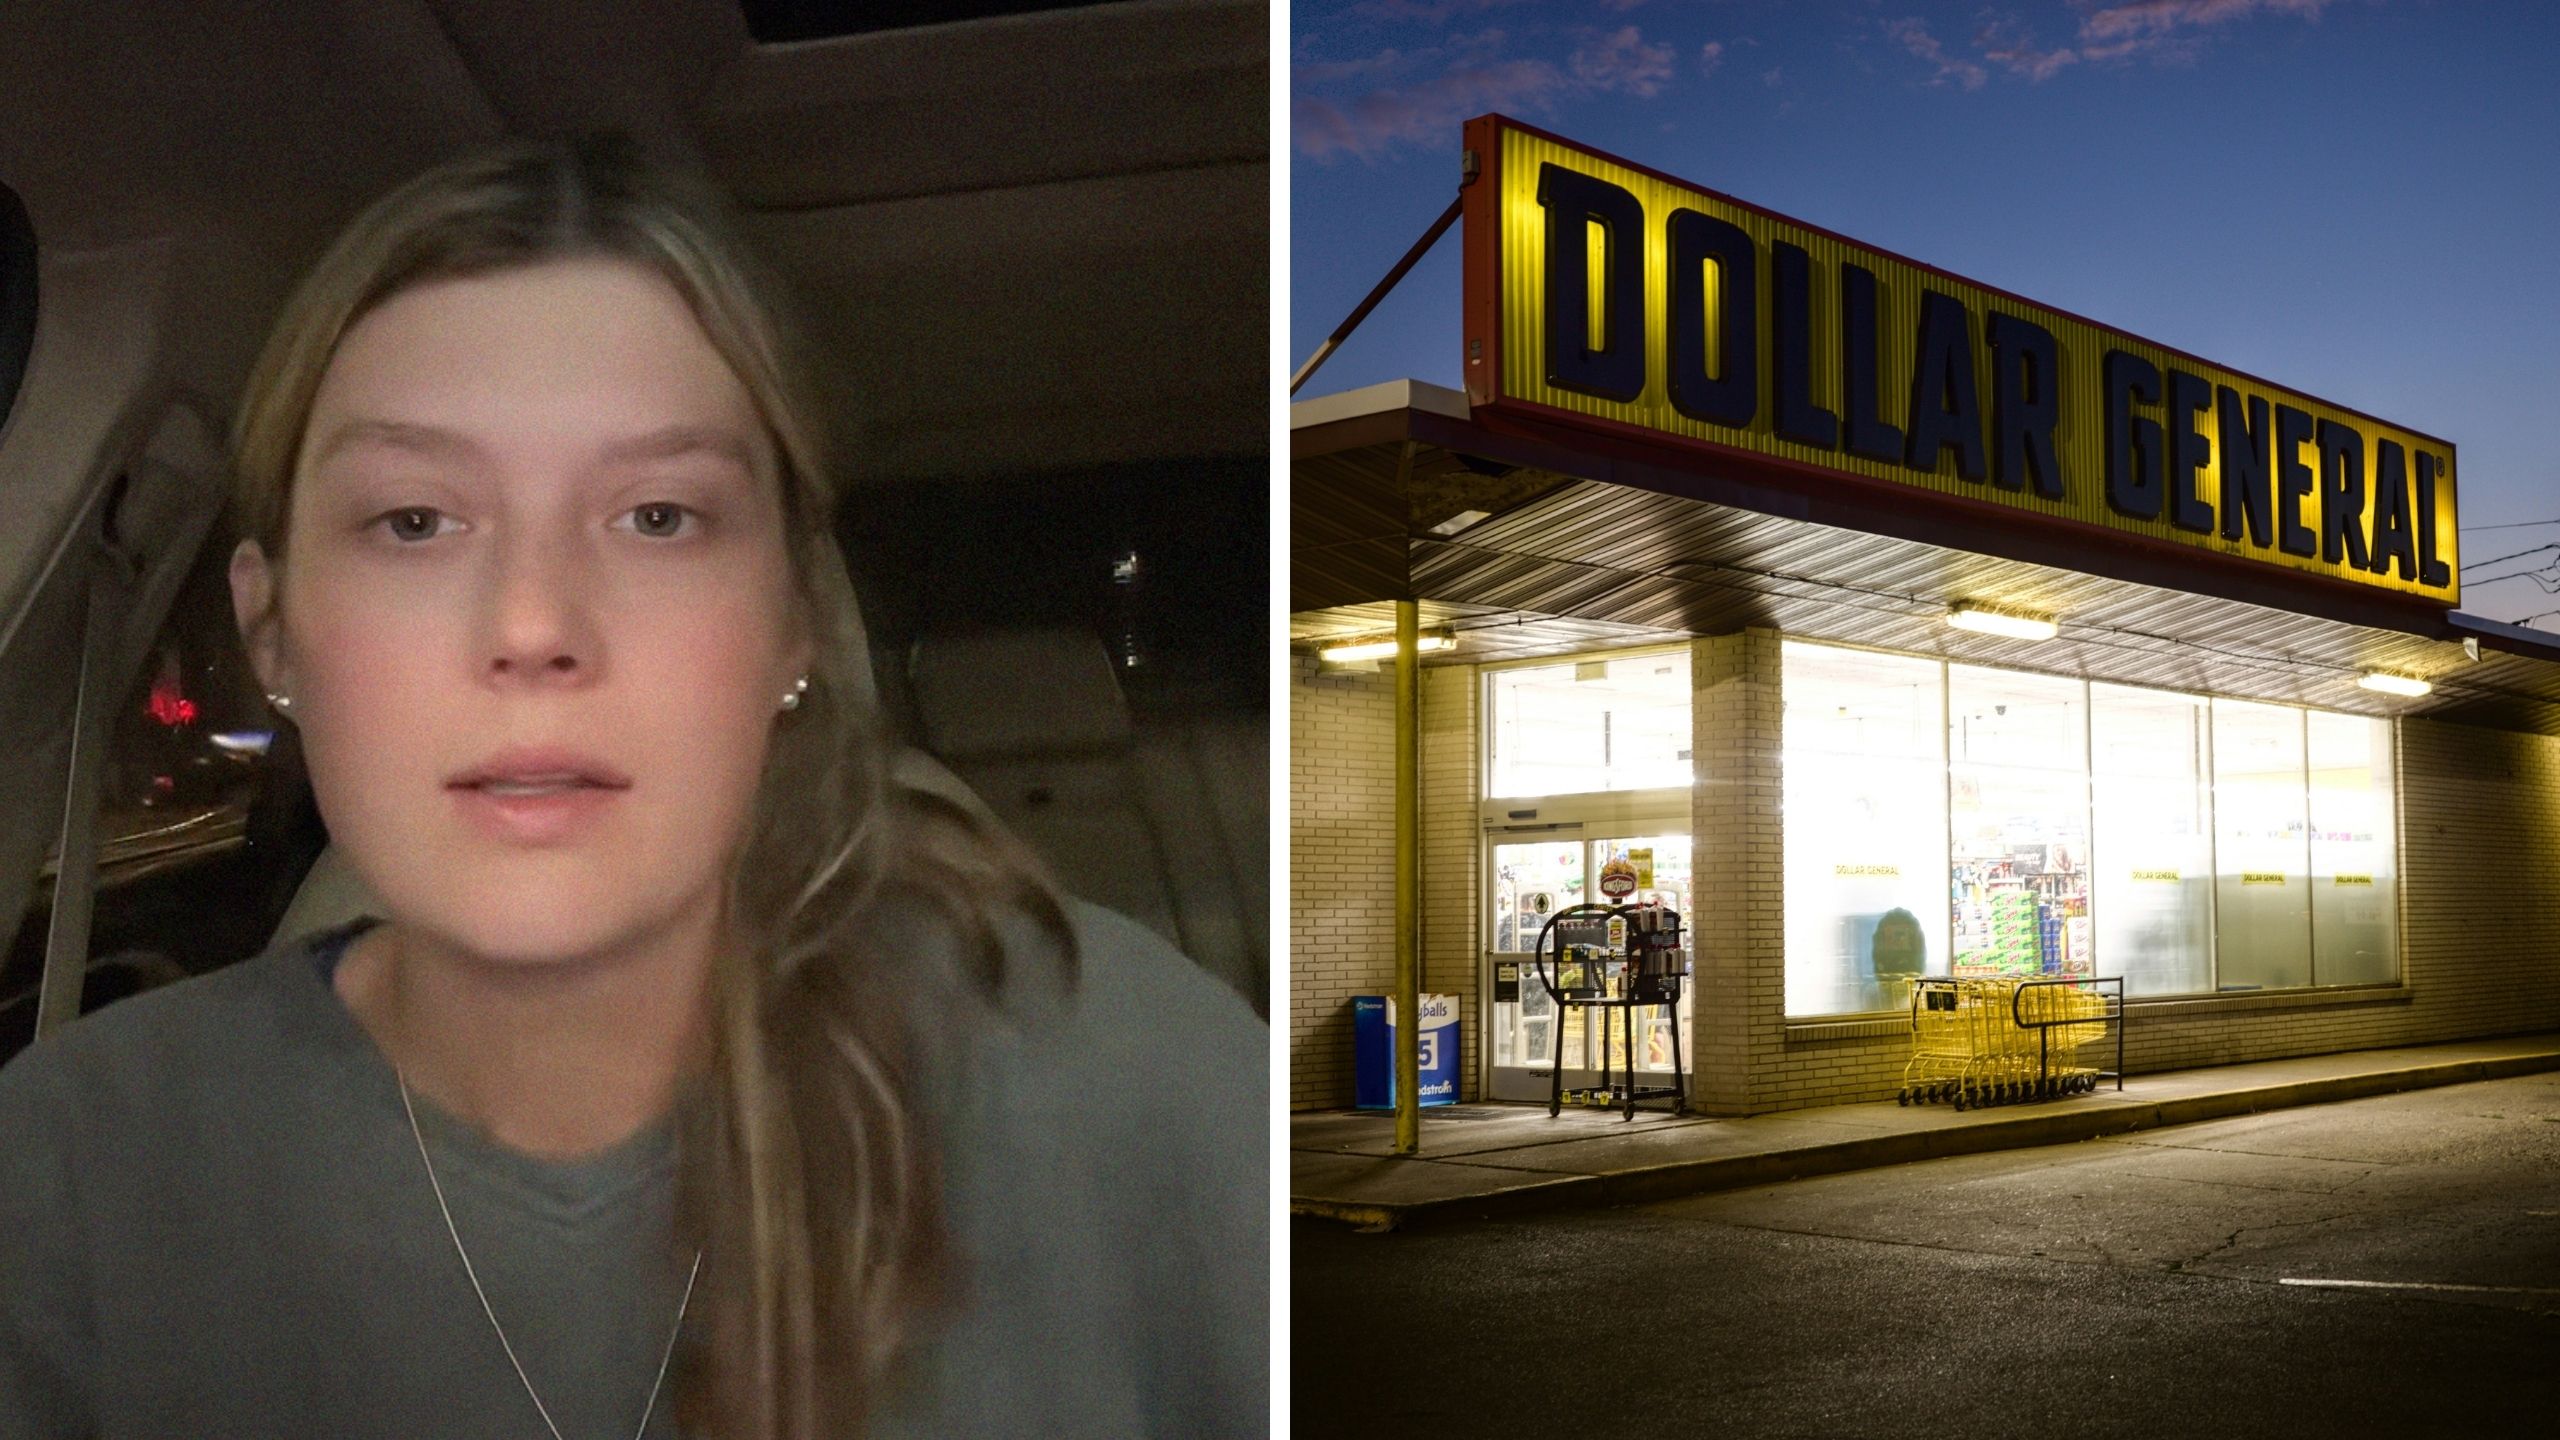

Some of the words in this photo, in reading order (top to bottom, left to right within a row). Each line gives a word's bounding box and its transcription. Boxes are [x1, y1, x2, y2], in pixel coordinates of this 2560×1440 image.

[1537, 161, 2063, 498] DOLLAR
[2103, 349, 2449, 588] GENERAL
[1836, 865, 1864, 875] DOLLAR
[1867, 865, 1899, 876] GENERAL
[2132, 871, 2153, 880] DOLLAR
[2155, 871, 2179, 881] GENERAL
[2244, 874, 2262, 882] DOLLAR
[2263, 874, 2284, 882] GENERAL
[1603, 877, 1633, 894] KINGSFORD
